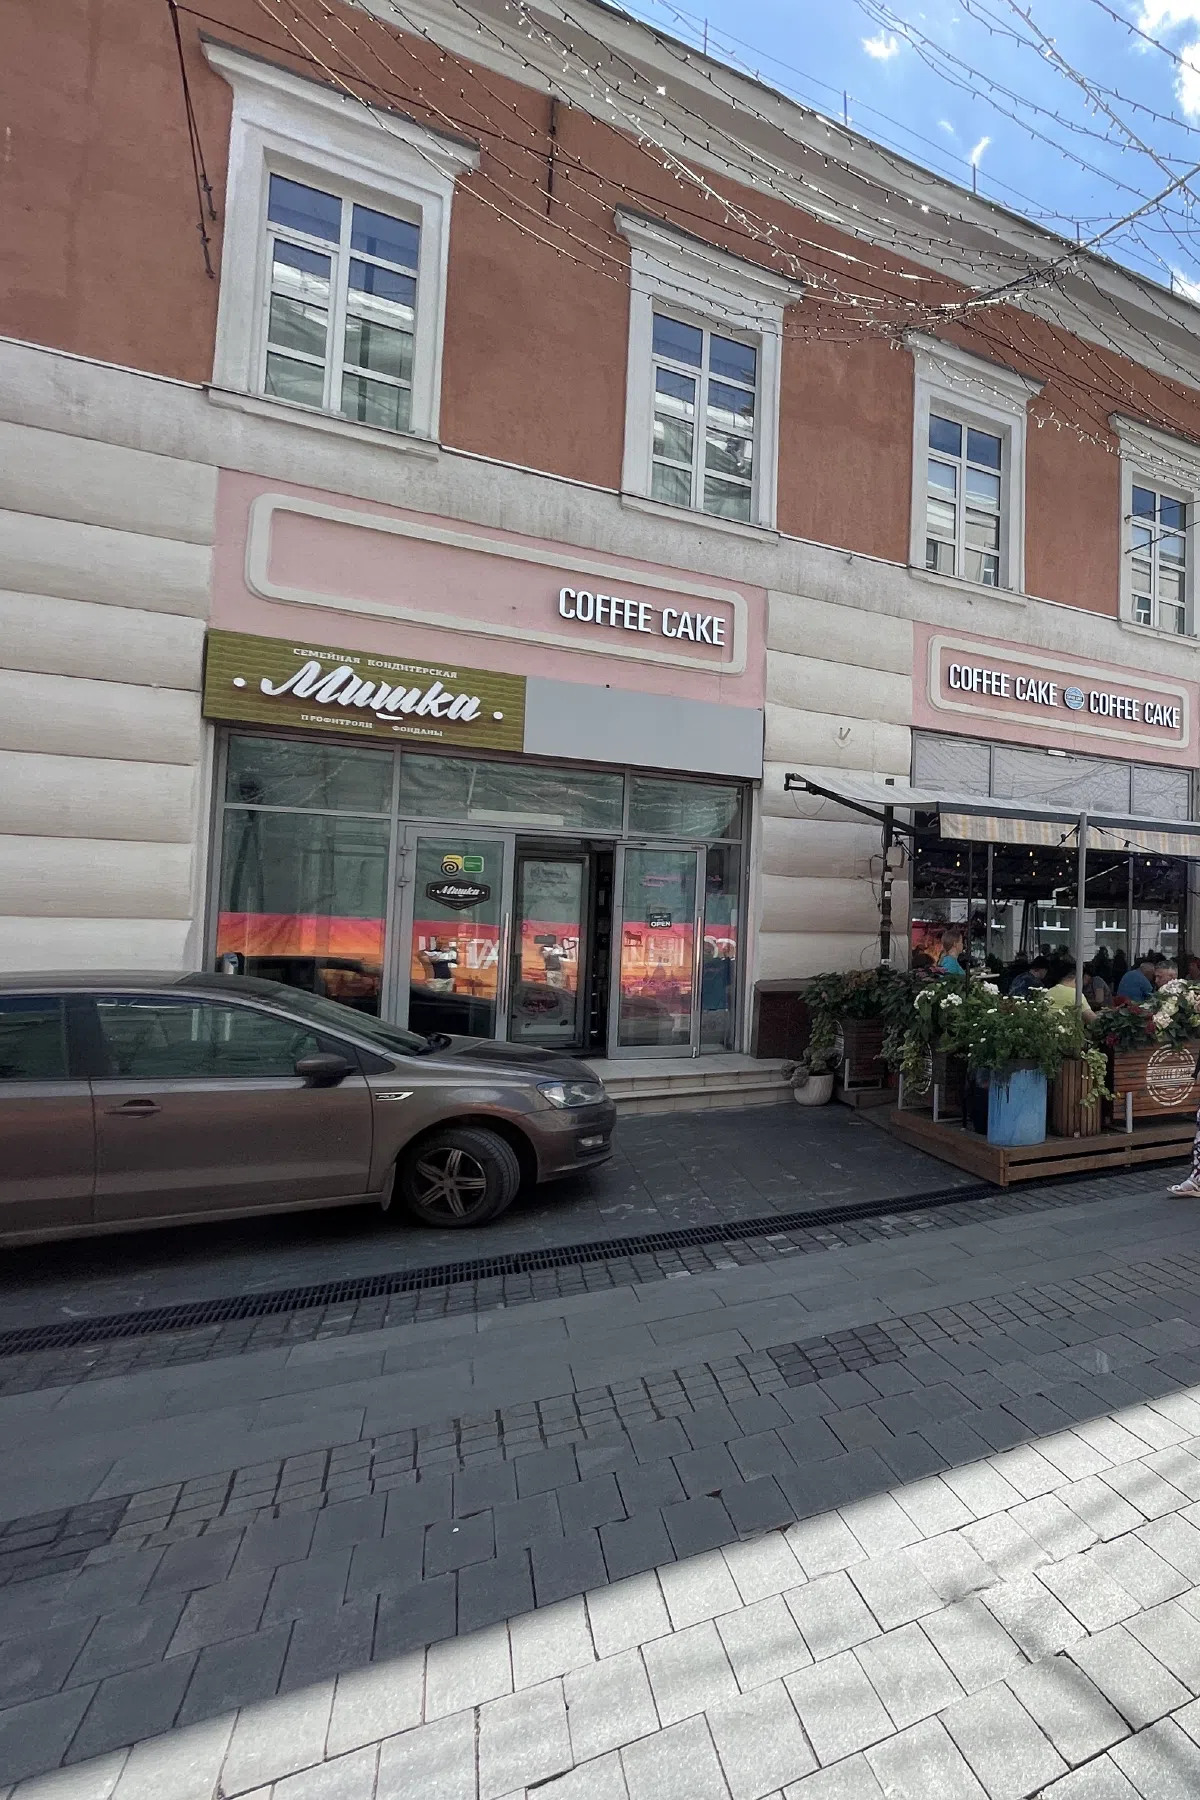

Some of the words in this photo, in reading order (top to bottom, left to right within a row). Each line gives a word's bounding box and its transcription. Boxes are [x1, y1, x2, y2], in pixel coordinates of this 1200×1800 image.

[559, 587, 652, 633] COFFEE
[662, 608, 725, 646] CAKE
[293, 648, 361, 664] СЕМЕЙНАЯ
[367, 659, 458, 679] КОНДИТЕРСКАЯ
[260, 660, 481, 722] Мишка
[949, 663, 1010, 698] COFFEE
[1015, 676, 1058, 706] CAKE
[1089, 690, 1140, 721] COFFEE
[1144, 702, 1180, 729] CAKE
[301, 714, 373, 729] ПРОФИТРОЛИ
[392, 725, 443, 737] ФОНДАНЫ
[650, 920, 671, 928] OPEN
